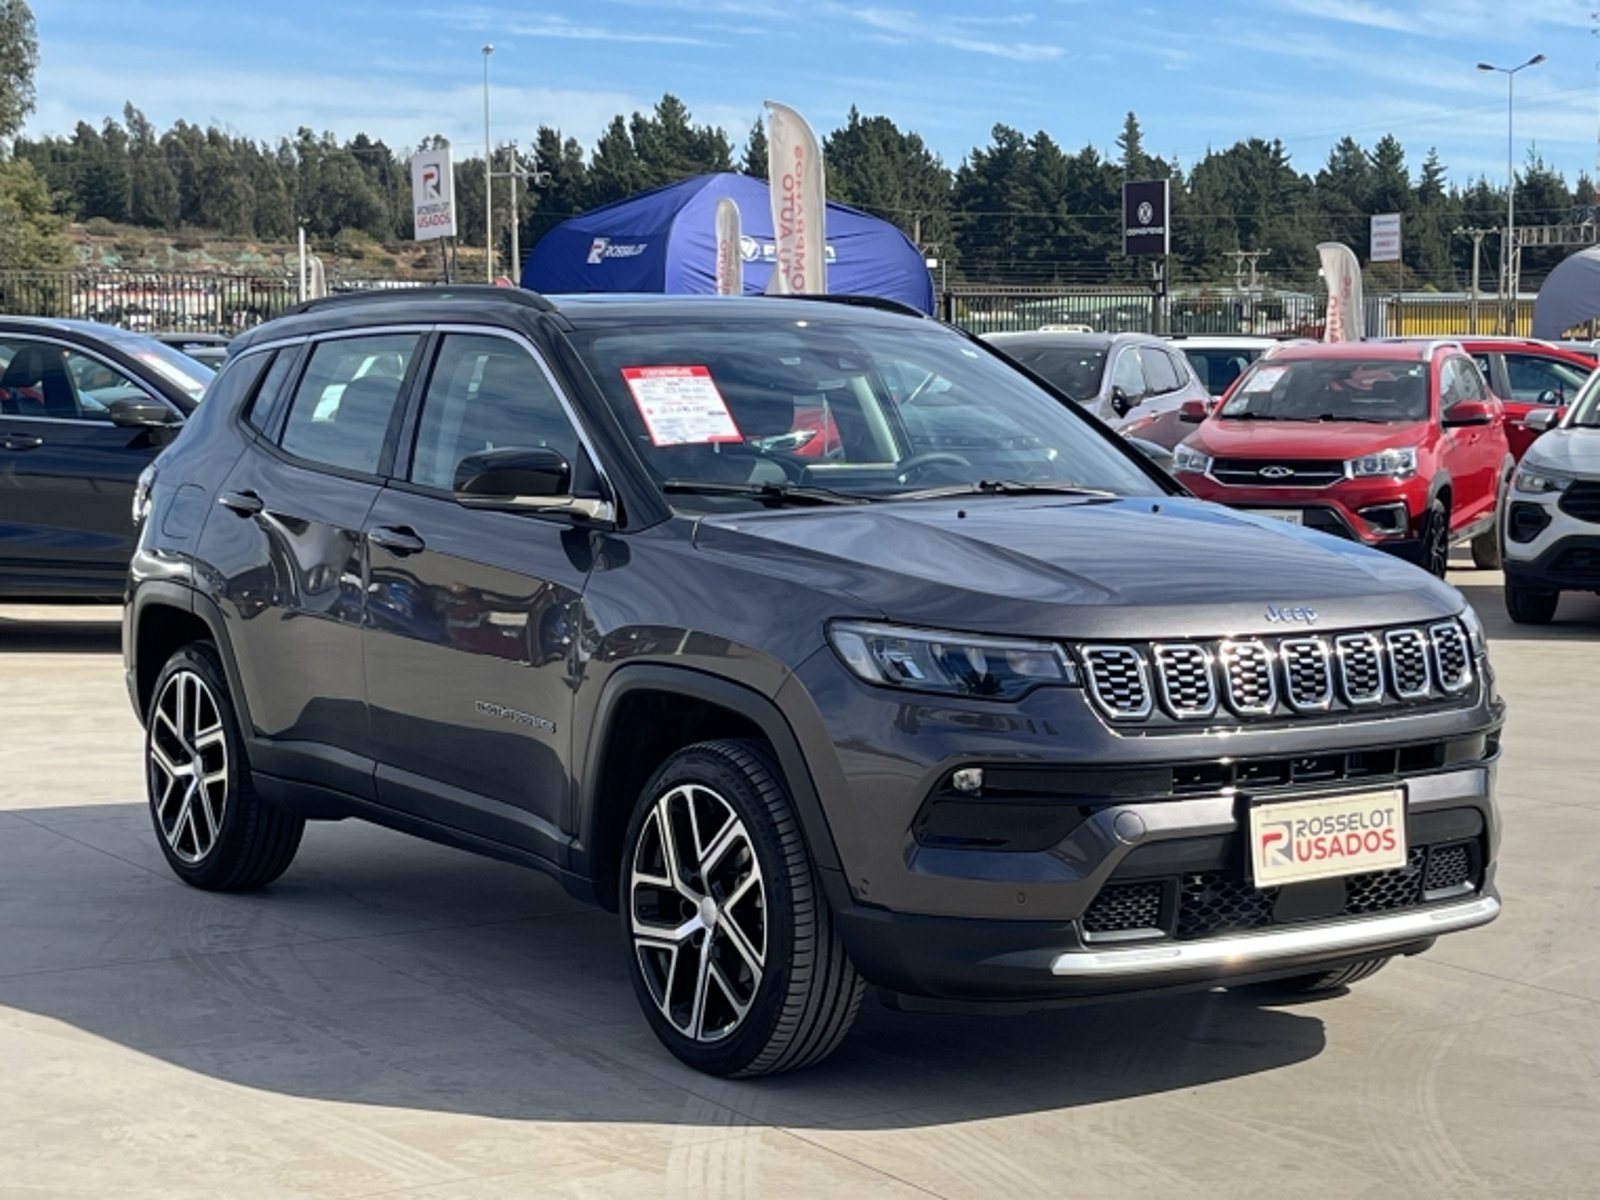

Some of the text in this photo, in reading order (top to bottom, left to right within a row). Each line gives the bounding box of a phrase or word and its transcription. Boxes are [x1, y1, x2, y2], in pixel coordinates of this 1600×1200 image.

[417, 212, 452, 229] USADOS
[1265, 604, 1319, 625] Jeep
[1296, 808, 1394, 838] ROSSELOT
[1296, 828, 1397, 862] USADOS
